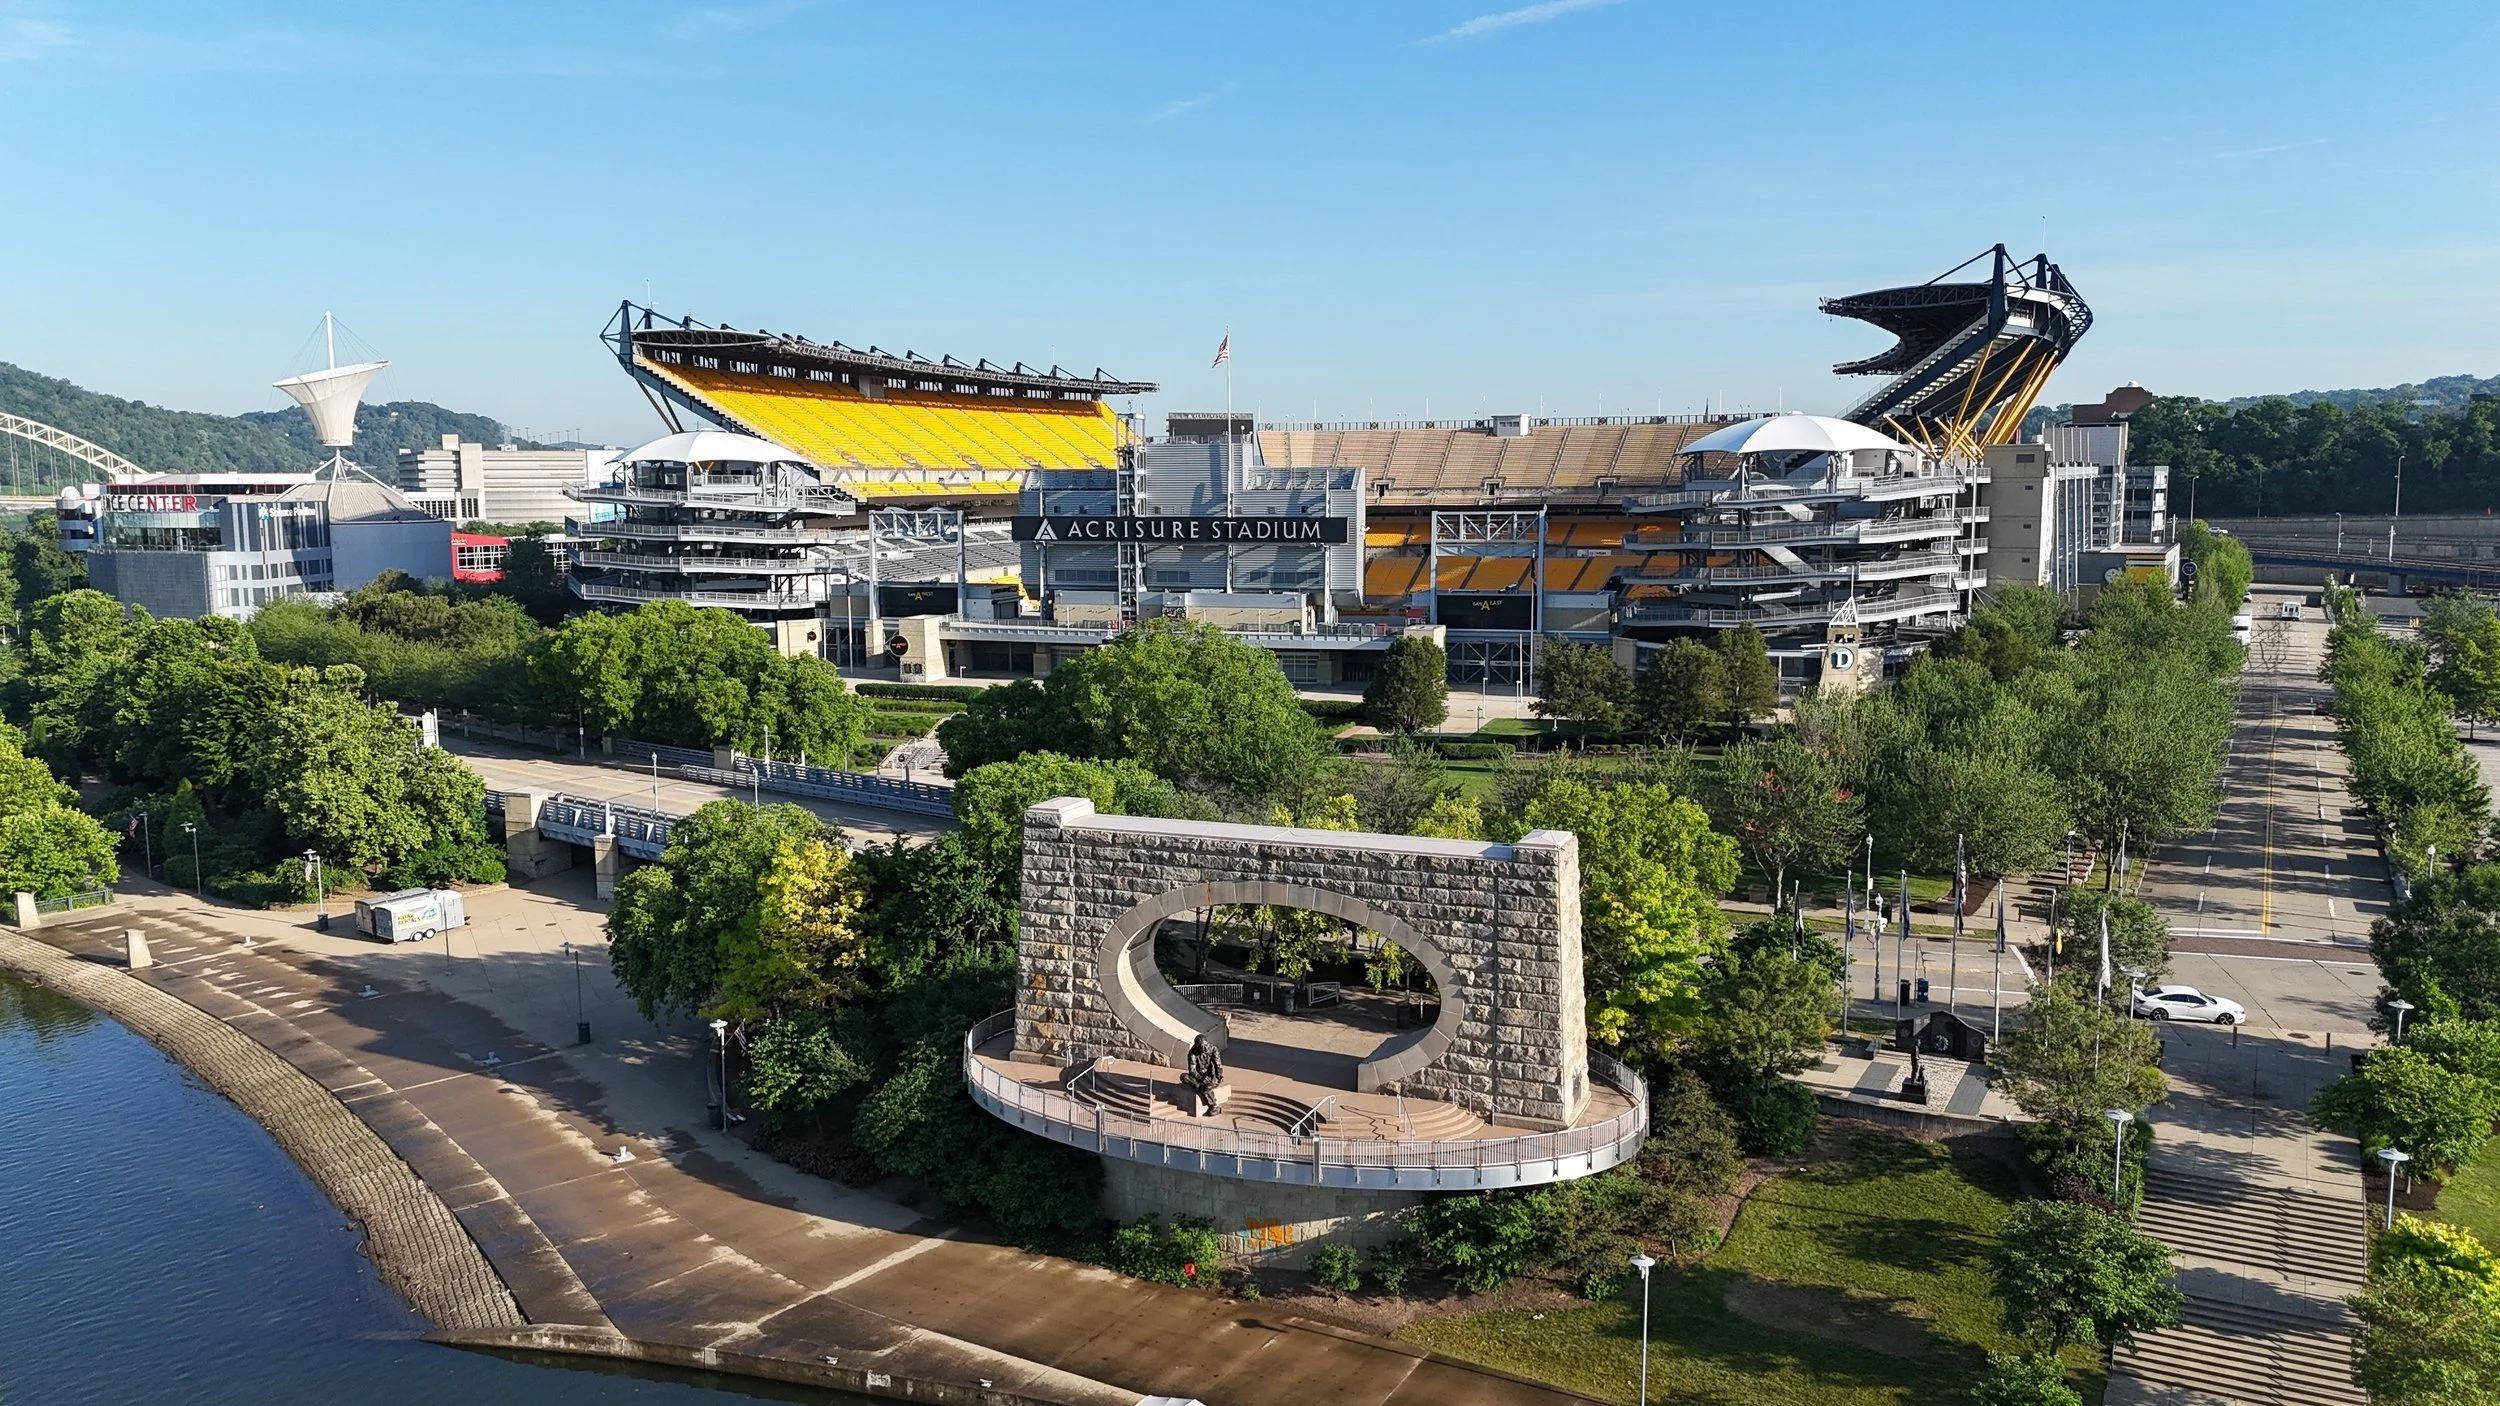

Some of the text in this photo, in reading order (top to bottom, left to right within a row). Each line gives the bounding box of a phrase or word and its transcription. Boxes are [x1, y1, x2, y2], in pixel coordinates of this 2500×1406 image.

[128, 495, 197, 512] CENTER
[269, 506, 292, 518] Science
[1067, 520, 1320, 539] ACRISURE STADIUM
[914, 591, 923, 600] A
[1480, 600, 1491, 611] A
[1836, 651, 1854, 668] D
